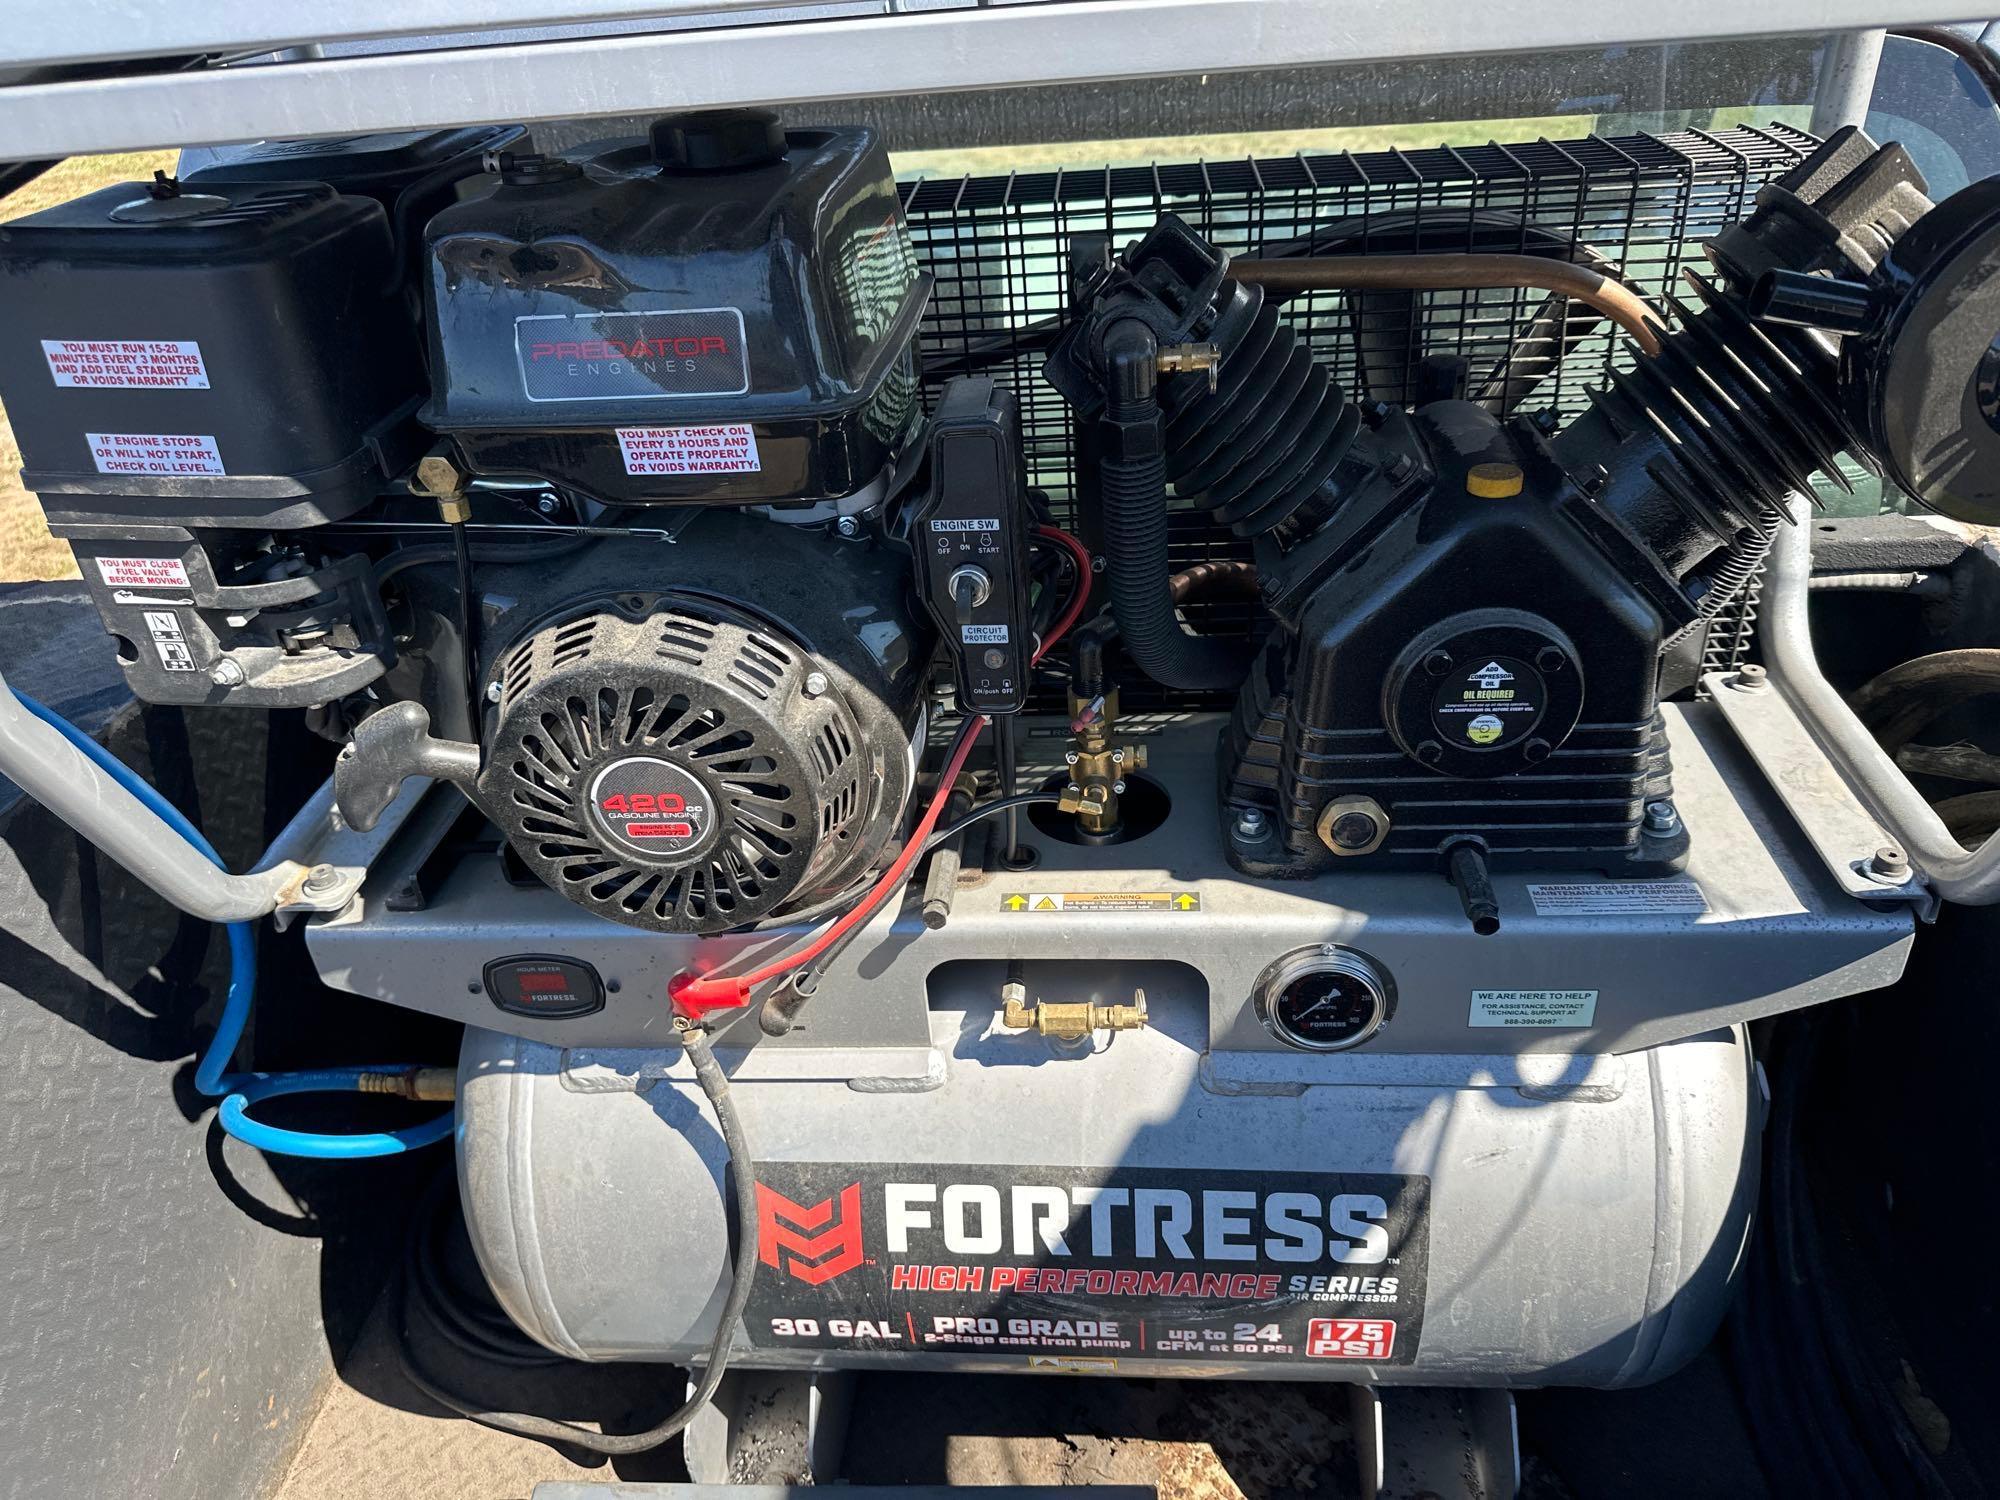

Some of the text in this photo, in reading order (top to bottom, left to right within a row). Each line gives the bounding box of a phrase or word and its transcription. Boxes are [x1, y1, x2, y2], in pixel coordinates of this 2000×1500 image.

[62, 343, 178, 354] YOU MUST RUN 15-20
[530, 336, 730, 362] PREDATOR
[50, 354, 199, 365] MINUTES EVERY 3 MONTHS
[56, 364, 202, 376] AND ADD FUEL STABILIZER
[568, 359, 696, 376] ENGINES
[72, 375, 89, 385] OR
[91, 375, 124, 385] VOIDS
[127, 376, 189, 387] WARRANTY
[618, 426, 749, 439] YOU MUST CHECK OIL
[100, 436, 202, 448] IF ENGINE STOPS
[626, 436, 748, 449] EVERY 8 HOURS AND
[96, 448, 216, 461] OR WILL NOT START,
[630, 448, 749, 461] OPERATE PROPERLY
[106, 461, 214, 473] CHECK OIL LEVEL.
[629, 462, 646, 473] OR
[648, 461, 685, 472] VOIDS
[688, 460, 754, 472] WARRANTY
[933, 520, 999, 531] ENGINE SW.
[959, 543, 971, 551] ON
[100, 559, 181, 569] YOU MUST CLOSE
[115, 568, 171, 577] FUEL VALVE
[109, 576, 145, 585] BEFORE
[967, 626, 1003, 635] CIRCUIT
[964, 634, 1008, 642] PROTECTOR
[1463, 689, 1515, 699] OIL REQUIRED
[1478, 992, 1494, 1000] WE
[1496, 992, 1517, 1000] ARE
[1519, 992, 1547, 1000] HERE
[1565, 992, 1592, 1000] HELP
[885, 1183, 1389, 1265] FORTRESS
[891, 1264, 1399, 1299] HIGH PERFORMANCE SERIES
[1312, 1292, 1398, 1303] COMPRESSOR
[771, 1317, 902, 1339] 30 GAL
[933, 1316, 1119, 1338] PRO GRADE
[1168, 1323, 1283, 1343] up to 24
[1317, 1322, 1383, 1342] 175
[924, 1333, 1131, 1349] 2-Stage cast iron pump
[1157, 1340, 1293, 1354] CFM at 90 PSI
[1313, 1341, 1385, 1356] PSI
